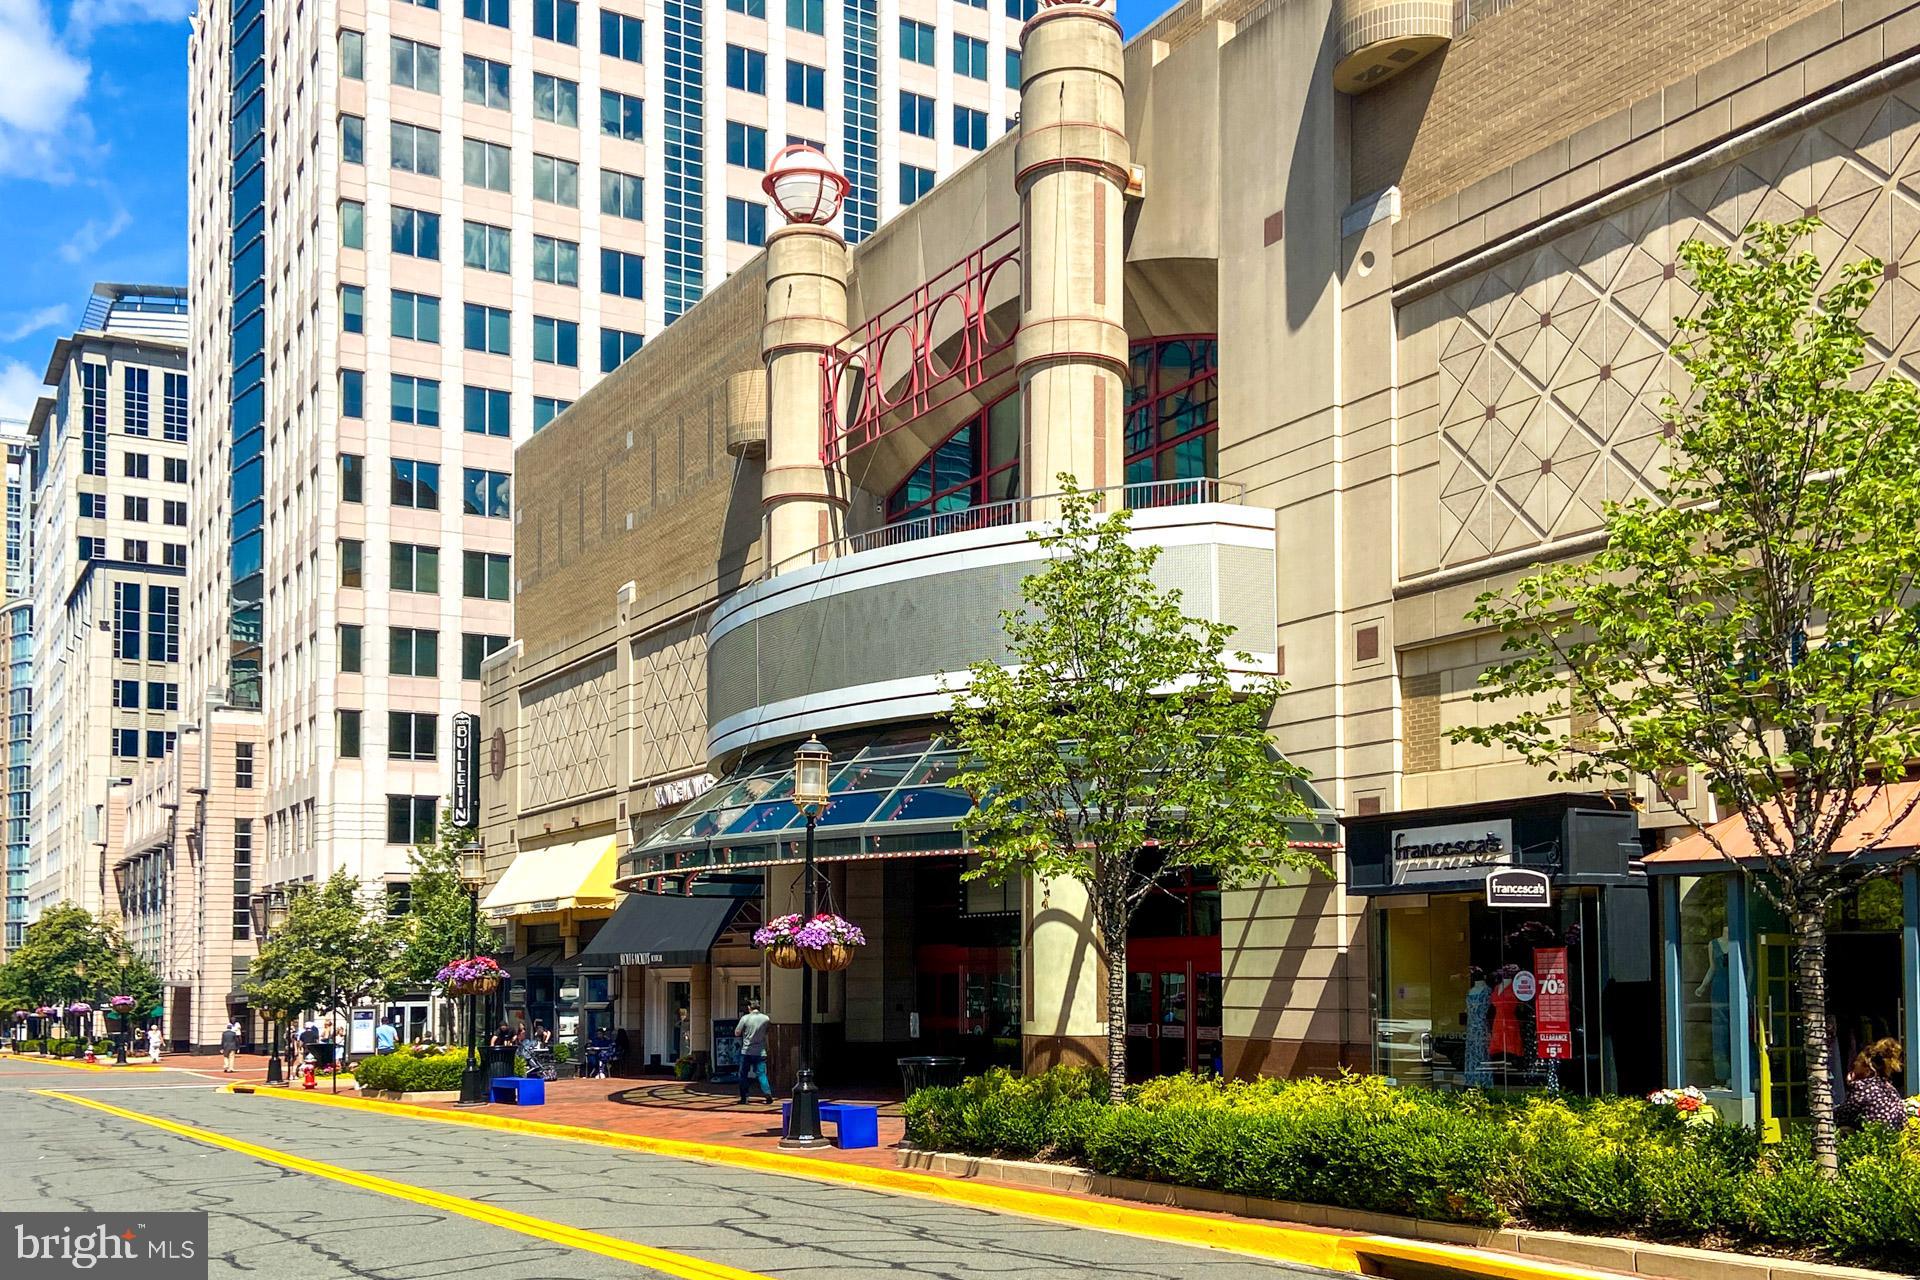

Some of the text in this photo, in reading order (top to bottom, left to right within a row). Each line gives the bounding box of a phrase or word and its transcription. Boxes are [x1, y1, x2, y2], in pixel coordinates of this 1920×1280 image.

[456, 725, 468, 820] BULLETIN
[1394, 831, 1504, 860] francesca's
[1492, 878, 1545, 894] francesca's
[1540, 1033, 1568, 1042] CLEARANCE
